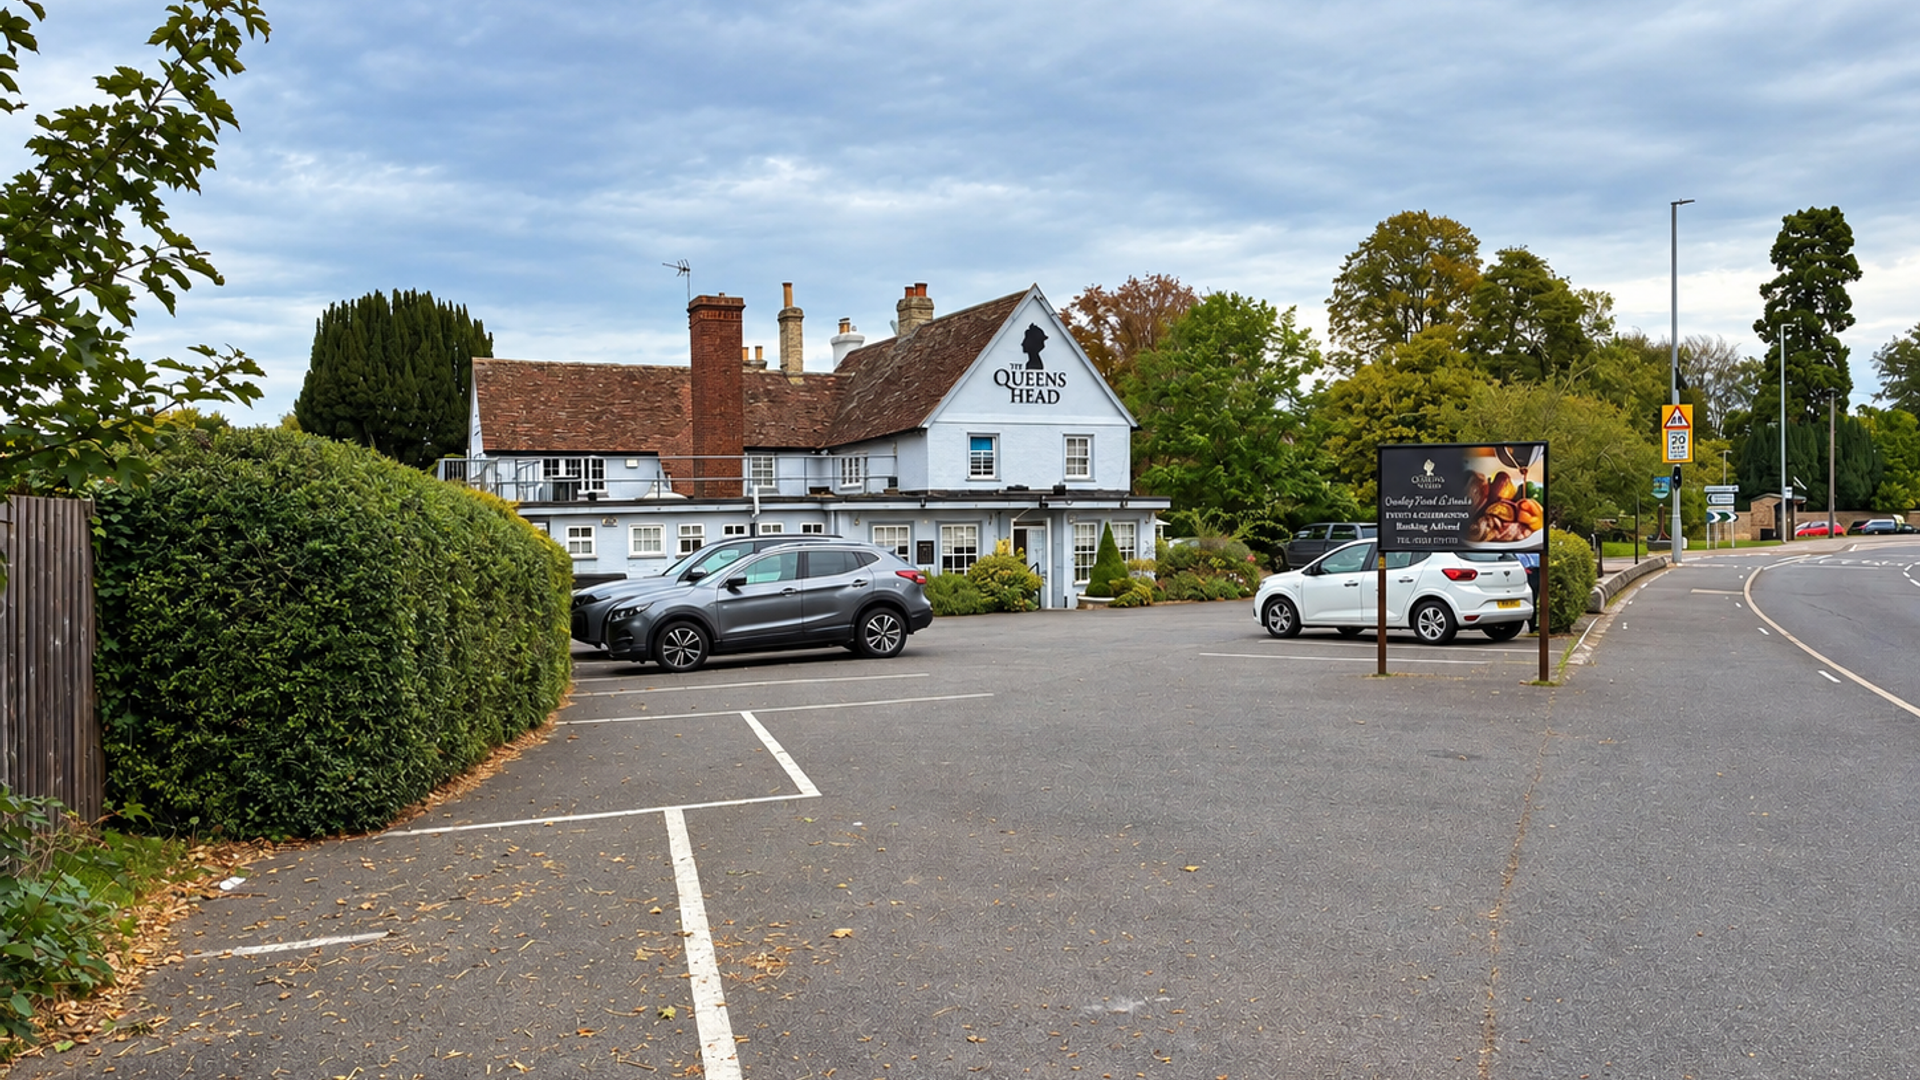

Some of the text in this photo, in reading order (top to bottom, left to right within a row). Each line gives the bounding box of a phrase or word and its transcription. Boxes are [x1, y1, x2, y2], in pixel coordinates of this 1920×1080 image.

[993, 368, 1067, 390] QUEENS
[1010, 388, 1060, 404] HEAD
[1671, 435, 1686, 445] 20
